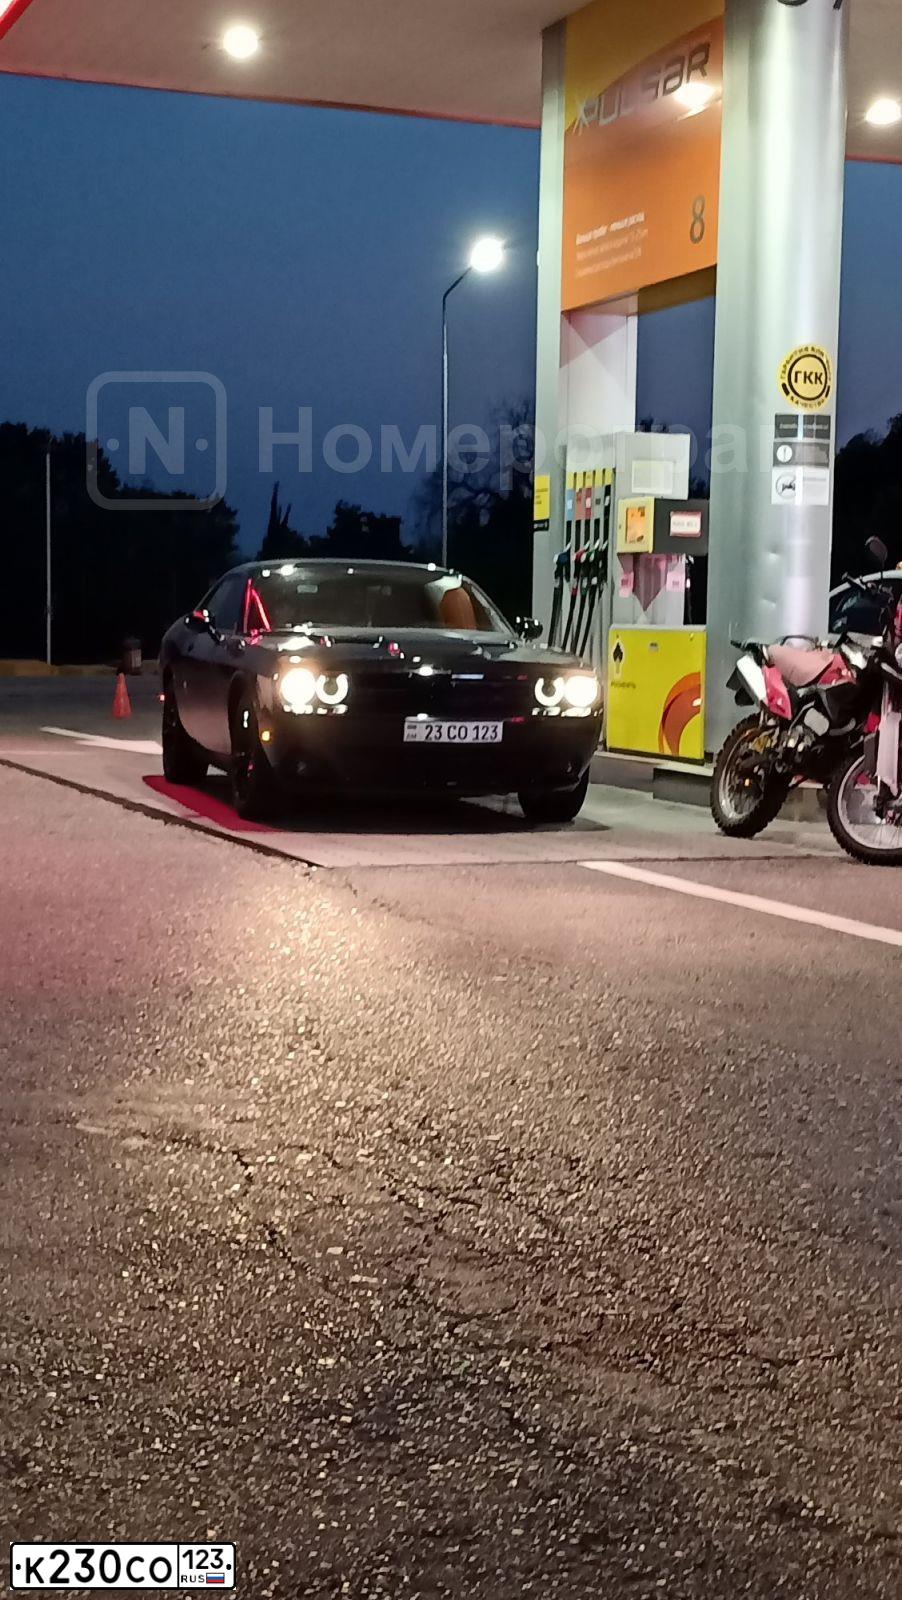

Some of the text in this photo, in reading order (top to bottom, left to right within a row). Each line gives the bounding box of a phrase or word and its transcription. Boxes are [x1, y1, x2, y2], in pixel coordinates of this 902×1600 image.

[690, 194, 706, 244] 8
[794, 370, 823, 386] ГКК
[425, 724, 498, 741] 23 CO 123
